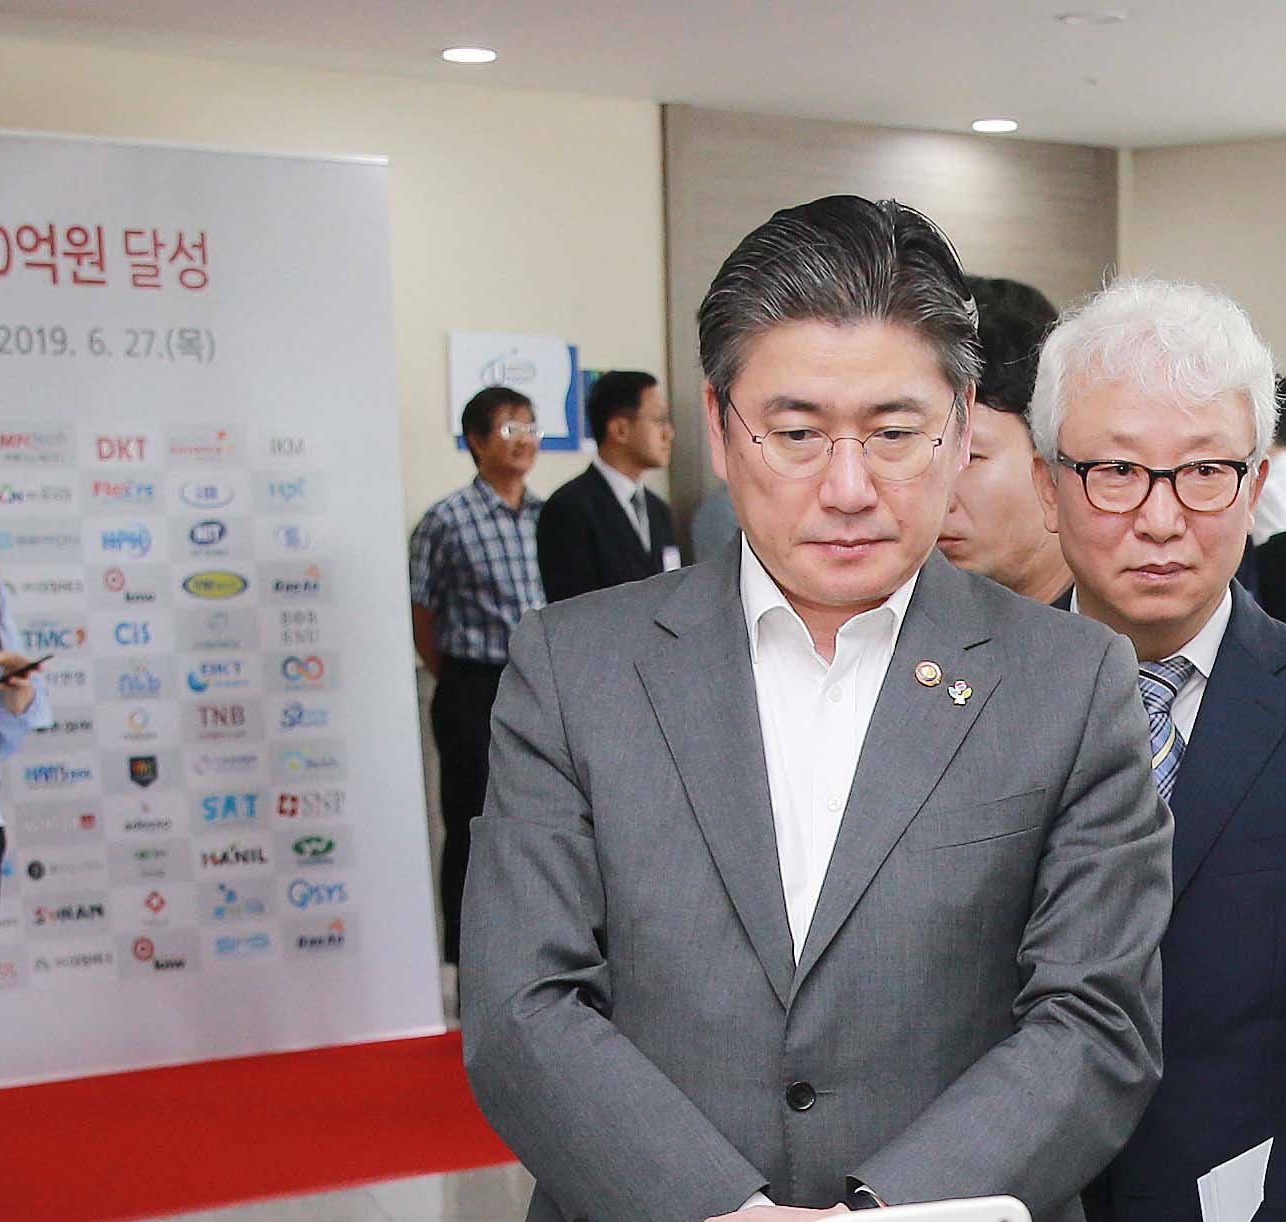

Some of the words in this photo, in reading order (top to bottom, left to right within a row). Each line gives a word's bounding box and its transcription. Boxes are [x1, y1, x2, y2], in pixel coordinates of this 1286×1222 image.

[122, 227, 211, 291] 달성
[95, 436, 147, 462] DKT
[202, 793, 261, 821] SAT
